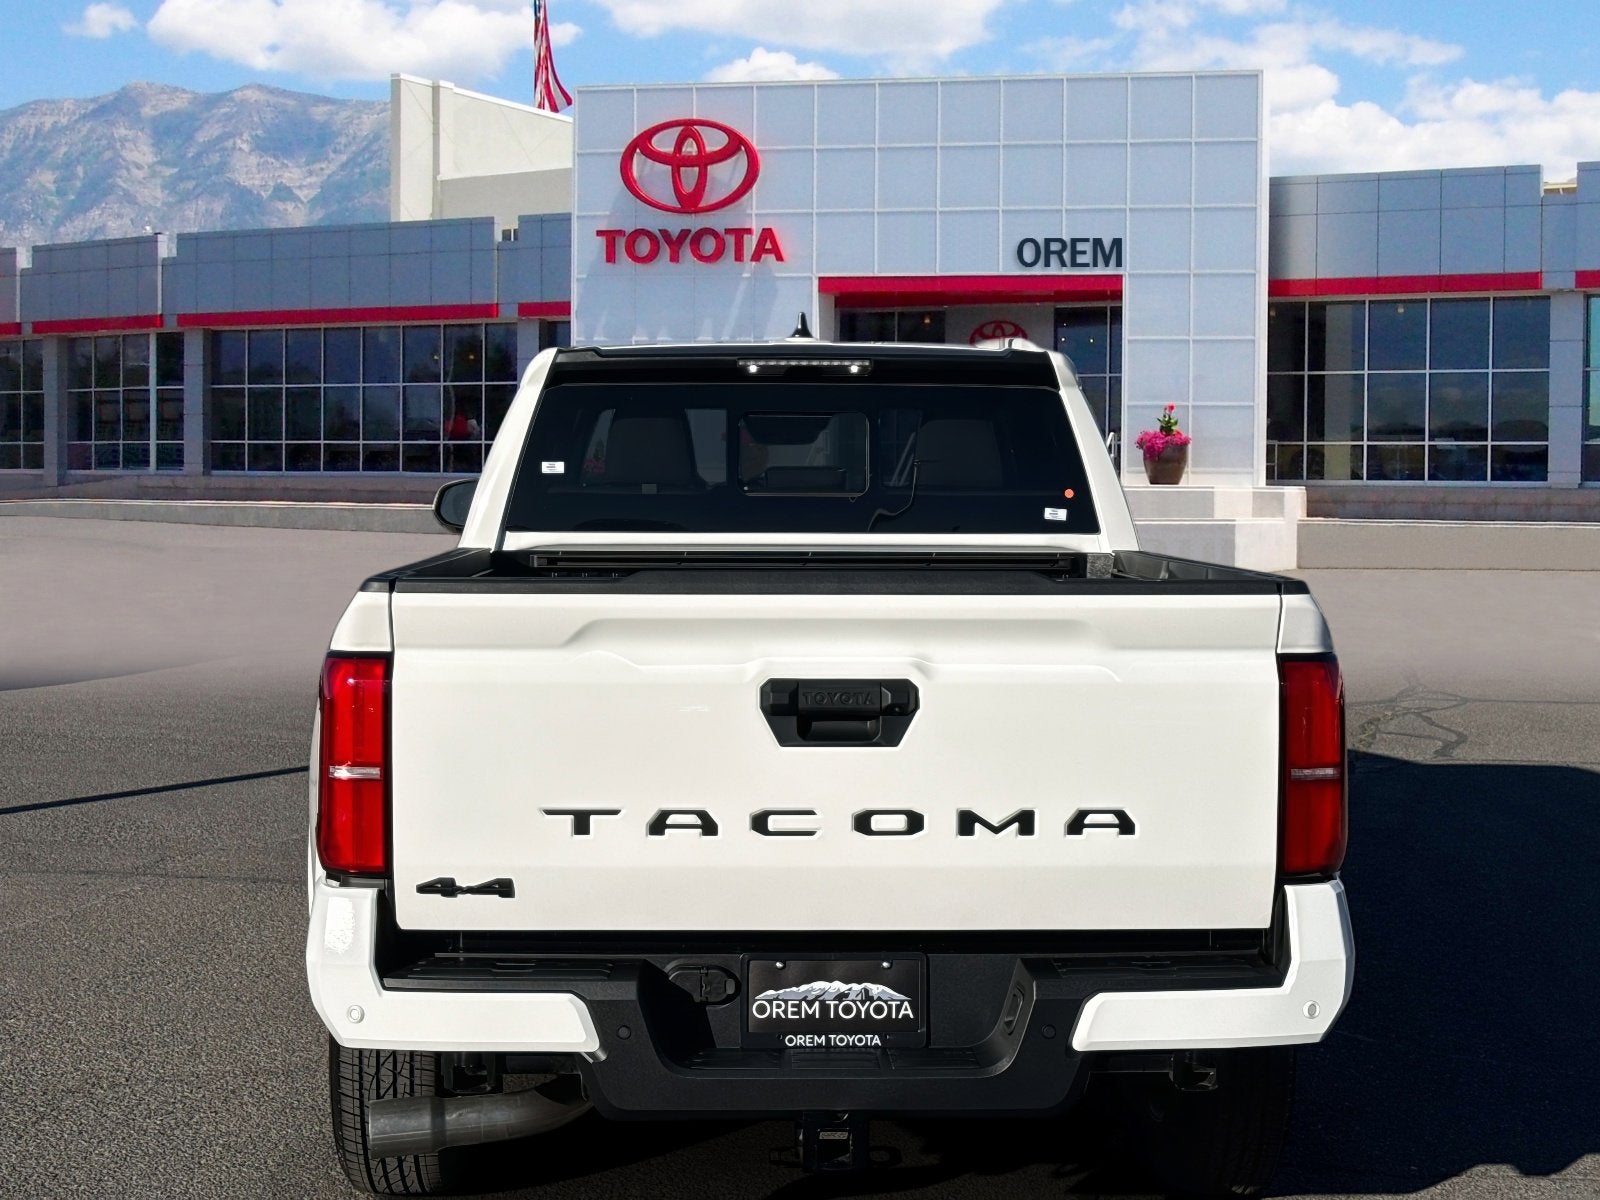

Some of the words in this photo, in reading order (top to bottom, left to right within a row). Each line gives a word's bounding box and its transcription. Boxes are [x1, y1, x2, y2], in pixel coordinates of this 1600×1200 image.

[596, 228, 785, 264] TOYOTA
[1016, 237, 1123, 269] OREM
[802, 691, 875, 705] TOYOTA
[541, 808, 1137, 837] TACOMA
[752, 1000, 820, 1019] OREM
[826, 1000, 914, 1019] TOYOTA
[785, 1034, 826, 1047] OREM
[829, 1034, 882, 1047] TOYOTA
